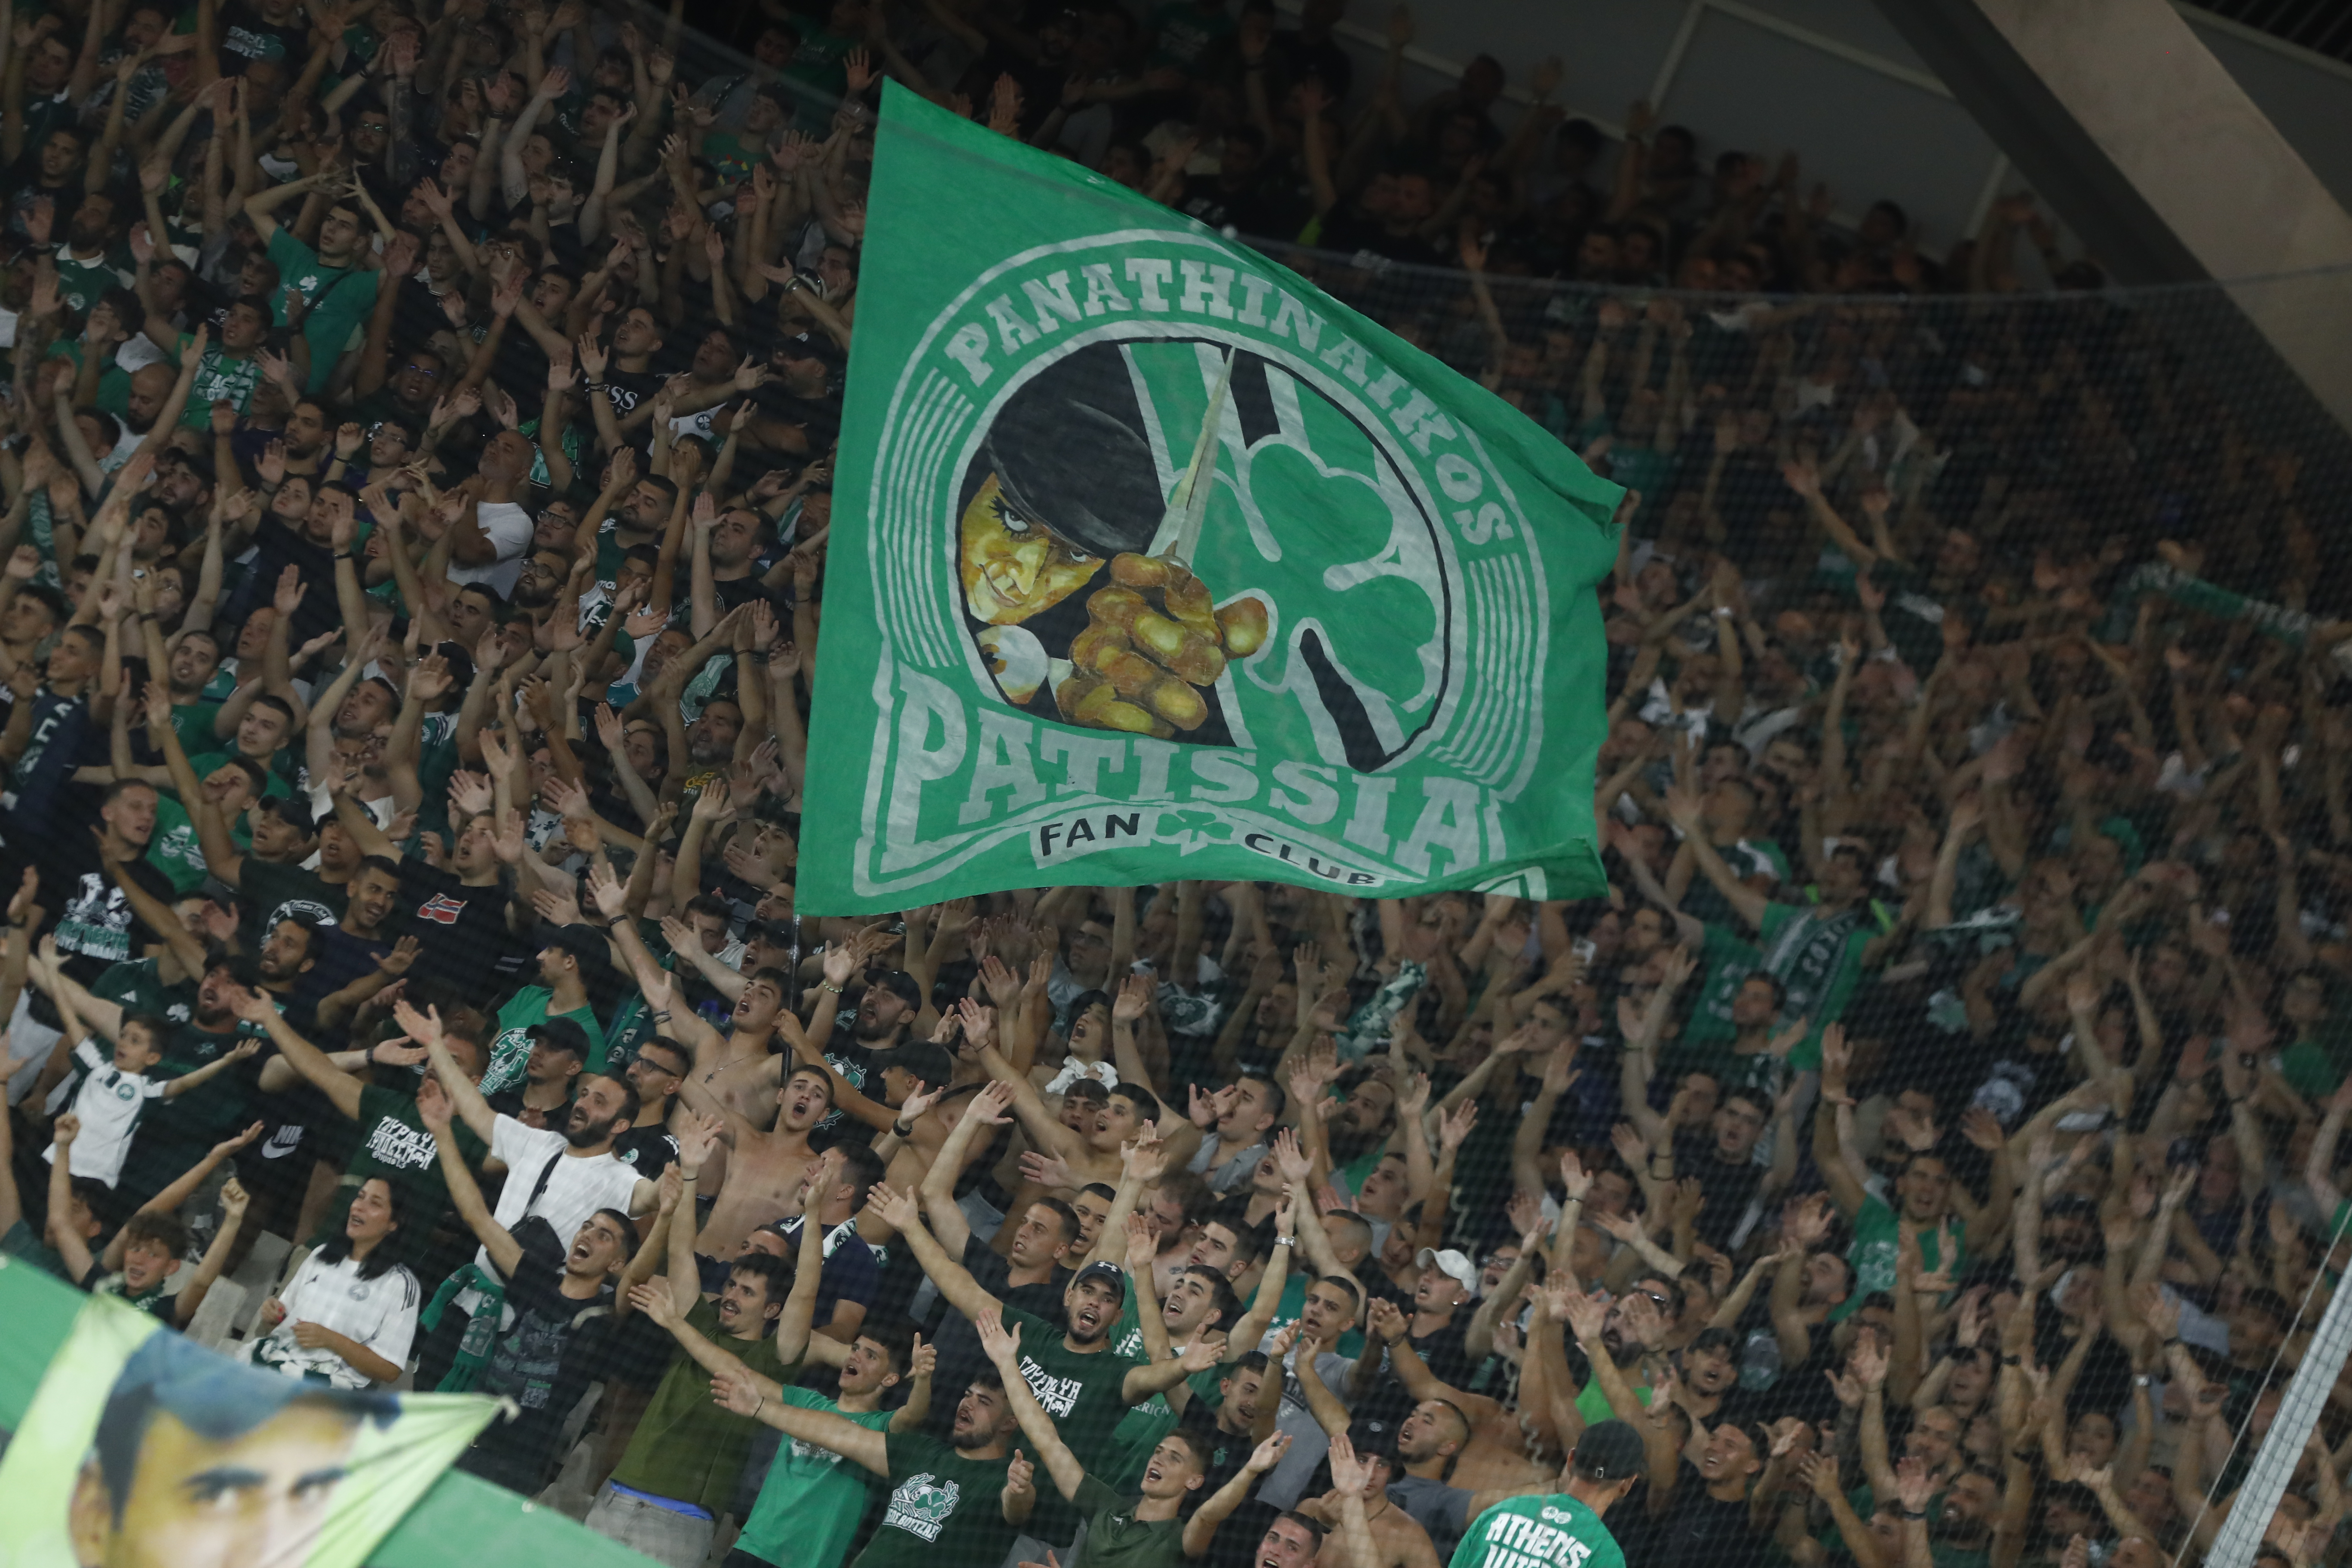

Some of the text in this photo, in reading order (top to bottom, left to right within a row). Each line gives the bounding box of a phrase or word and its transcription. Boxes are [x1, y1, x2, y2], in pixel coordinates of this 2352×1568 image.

[944, 258, 1513, 545] PANATHINAIKOS
[880, 660, 1483, 874] PATISSIA
[1040, 813, 1376, 885] FAN CLUB
[1485, 1512, 1592, 1568] ATHENS
